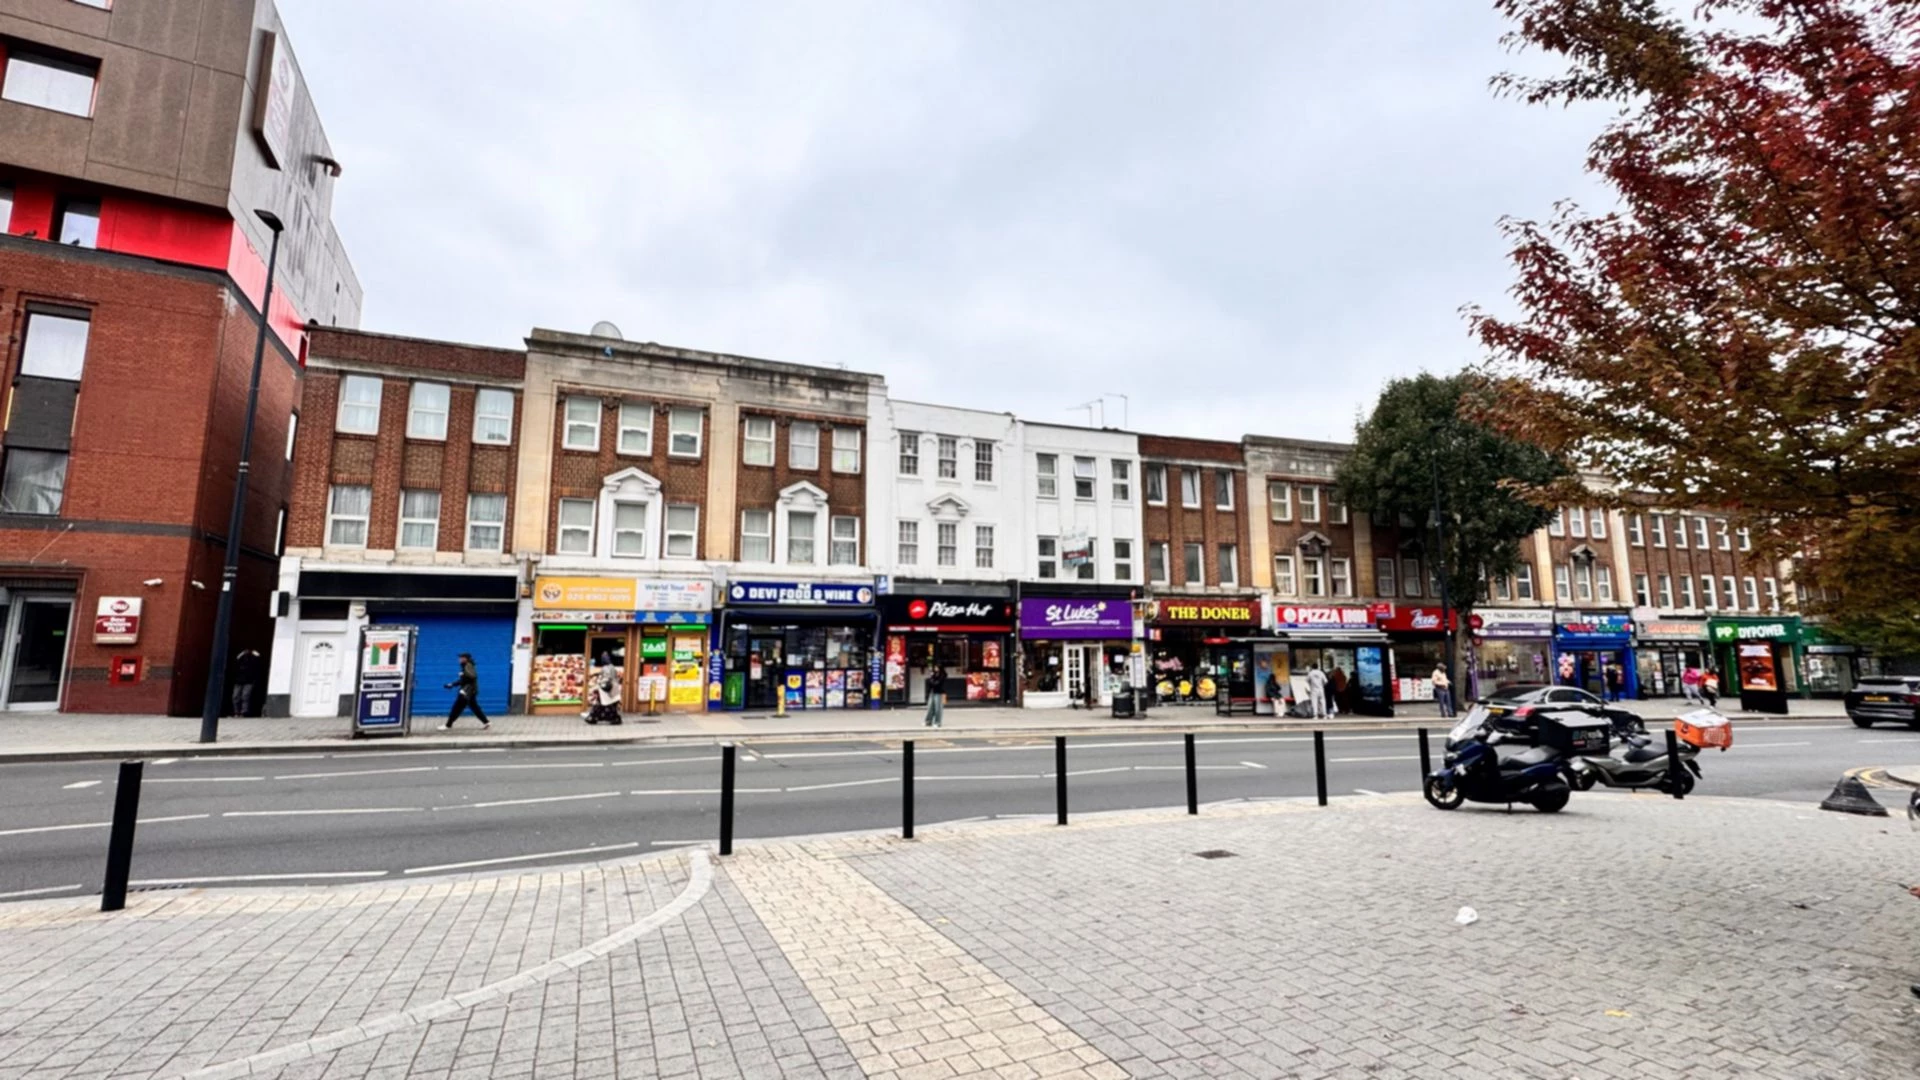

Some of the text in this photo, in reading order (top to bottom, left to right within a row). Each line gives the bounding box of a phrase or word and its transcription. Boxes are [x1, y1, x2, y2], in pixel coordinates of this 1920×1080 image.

[749, 588, 777, 599] DEVI
[779, 589, 812, 600] FOOD
[824, 590, 854, 601] WINE
[928, 602, 993, 618] Pizza Hut
[1045, 604, 1099, 621] St Luke's
[1168, 606, 1251, 620] THE DONER
[1298, 608, 1341, 623] PIZZA
